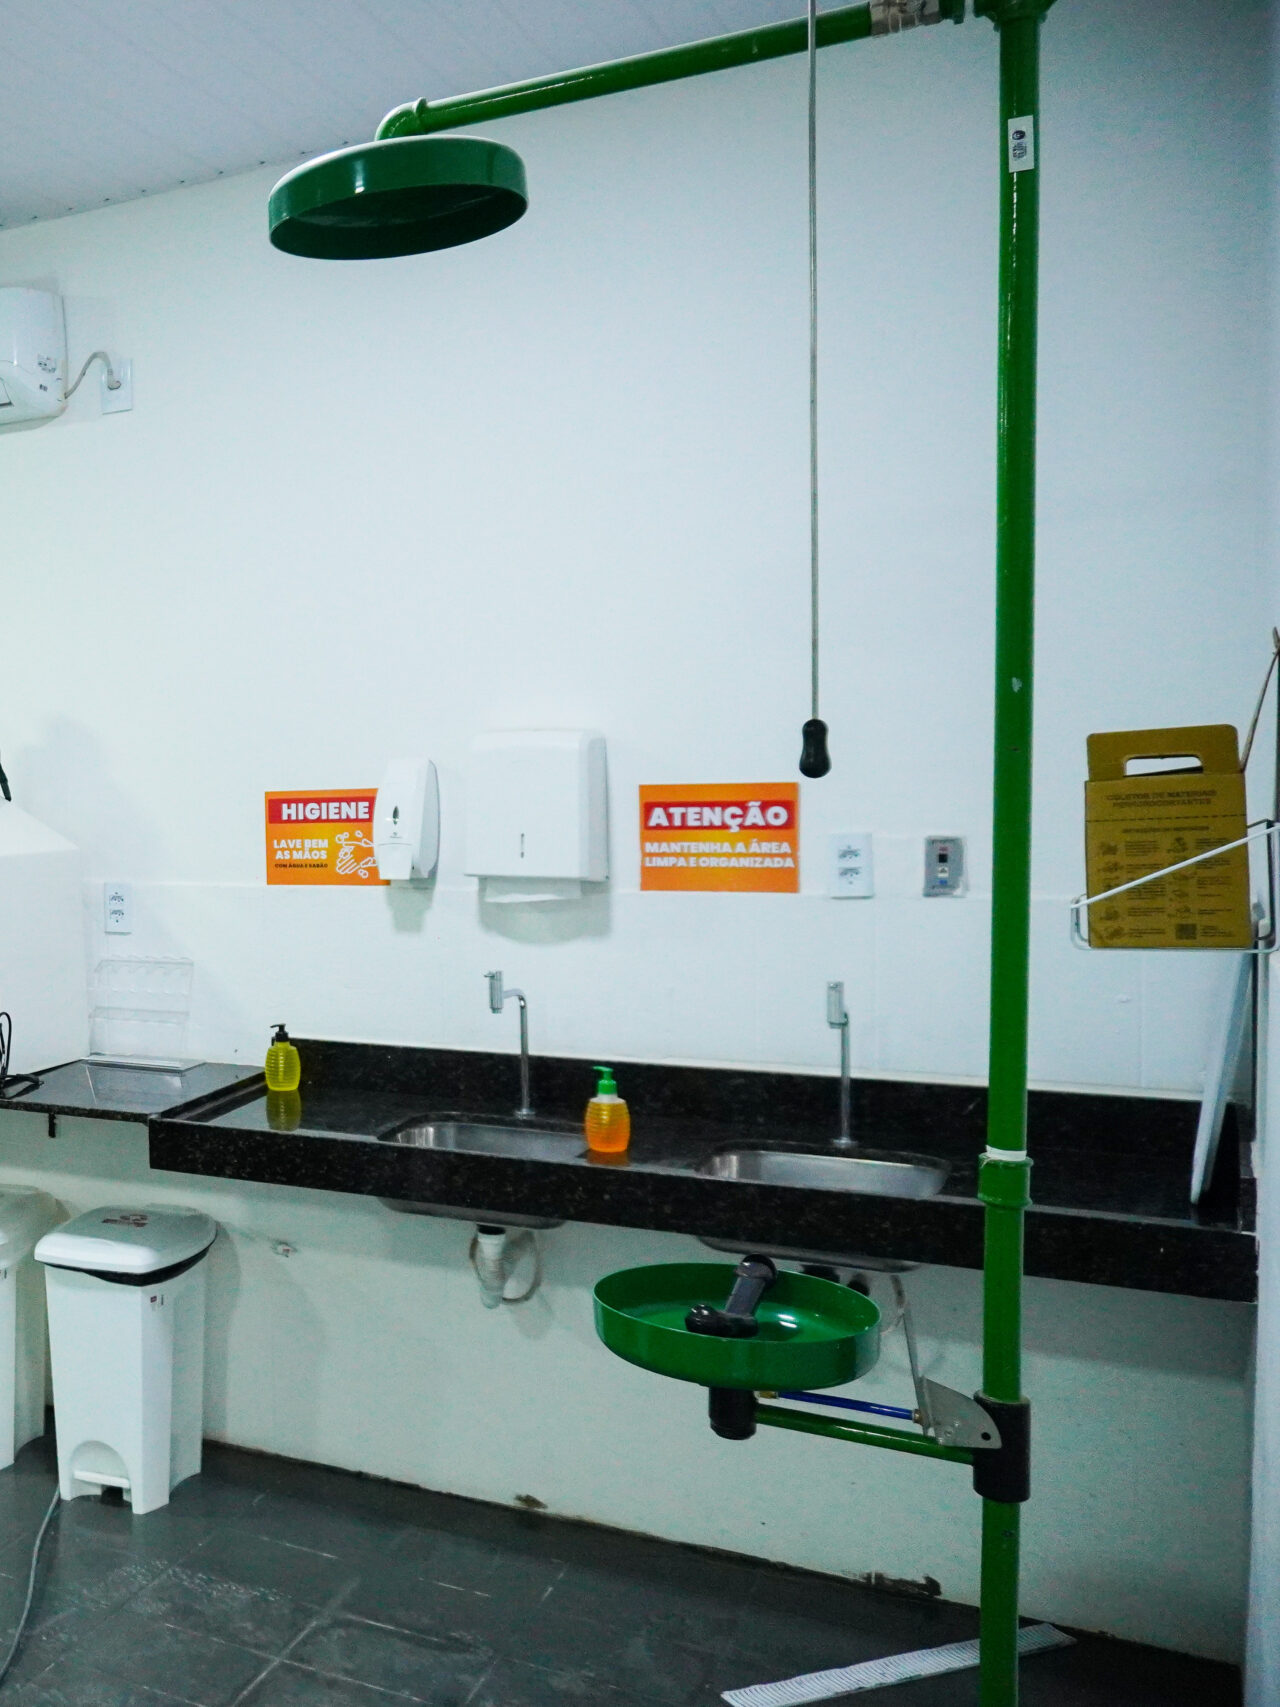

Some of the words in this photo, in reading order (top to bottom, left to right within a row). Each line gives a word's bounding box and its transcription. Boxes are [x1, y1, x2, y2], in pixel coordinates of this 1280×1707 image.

[282, 802, 369, 820] HIGIENE
[648, 801, 789, 833] ATENÇÃO
[274, 839, 302, 848] LAVE
[304, 839, 328, 848] BEM
[645, 842, 732, 853] MANTENHA
[735, 842, 747, 854] A
[749, 838, 791, 853] ÁREA
[276, 850, 290, 859] AS
[293, 848, 327, 859] MÃOS
[645, 856, 687, 867] LIMPA
[689, 857, 697, 867] E
[699, 856, 795, 868] ORGANIZADA
